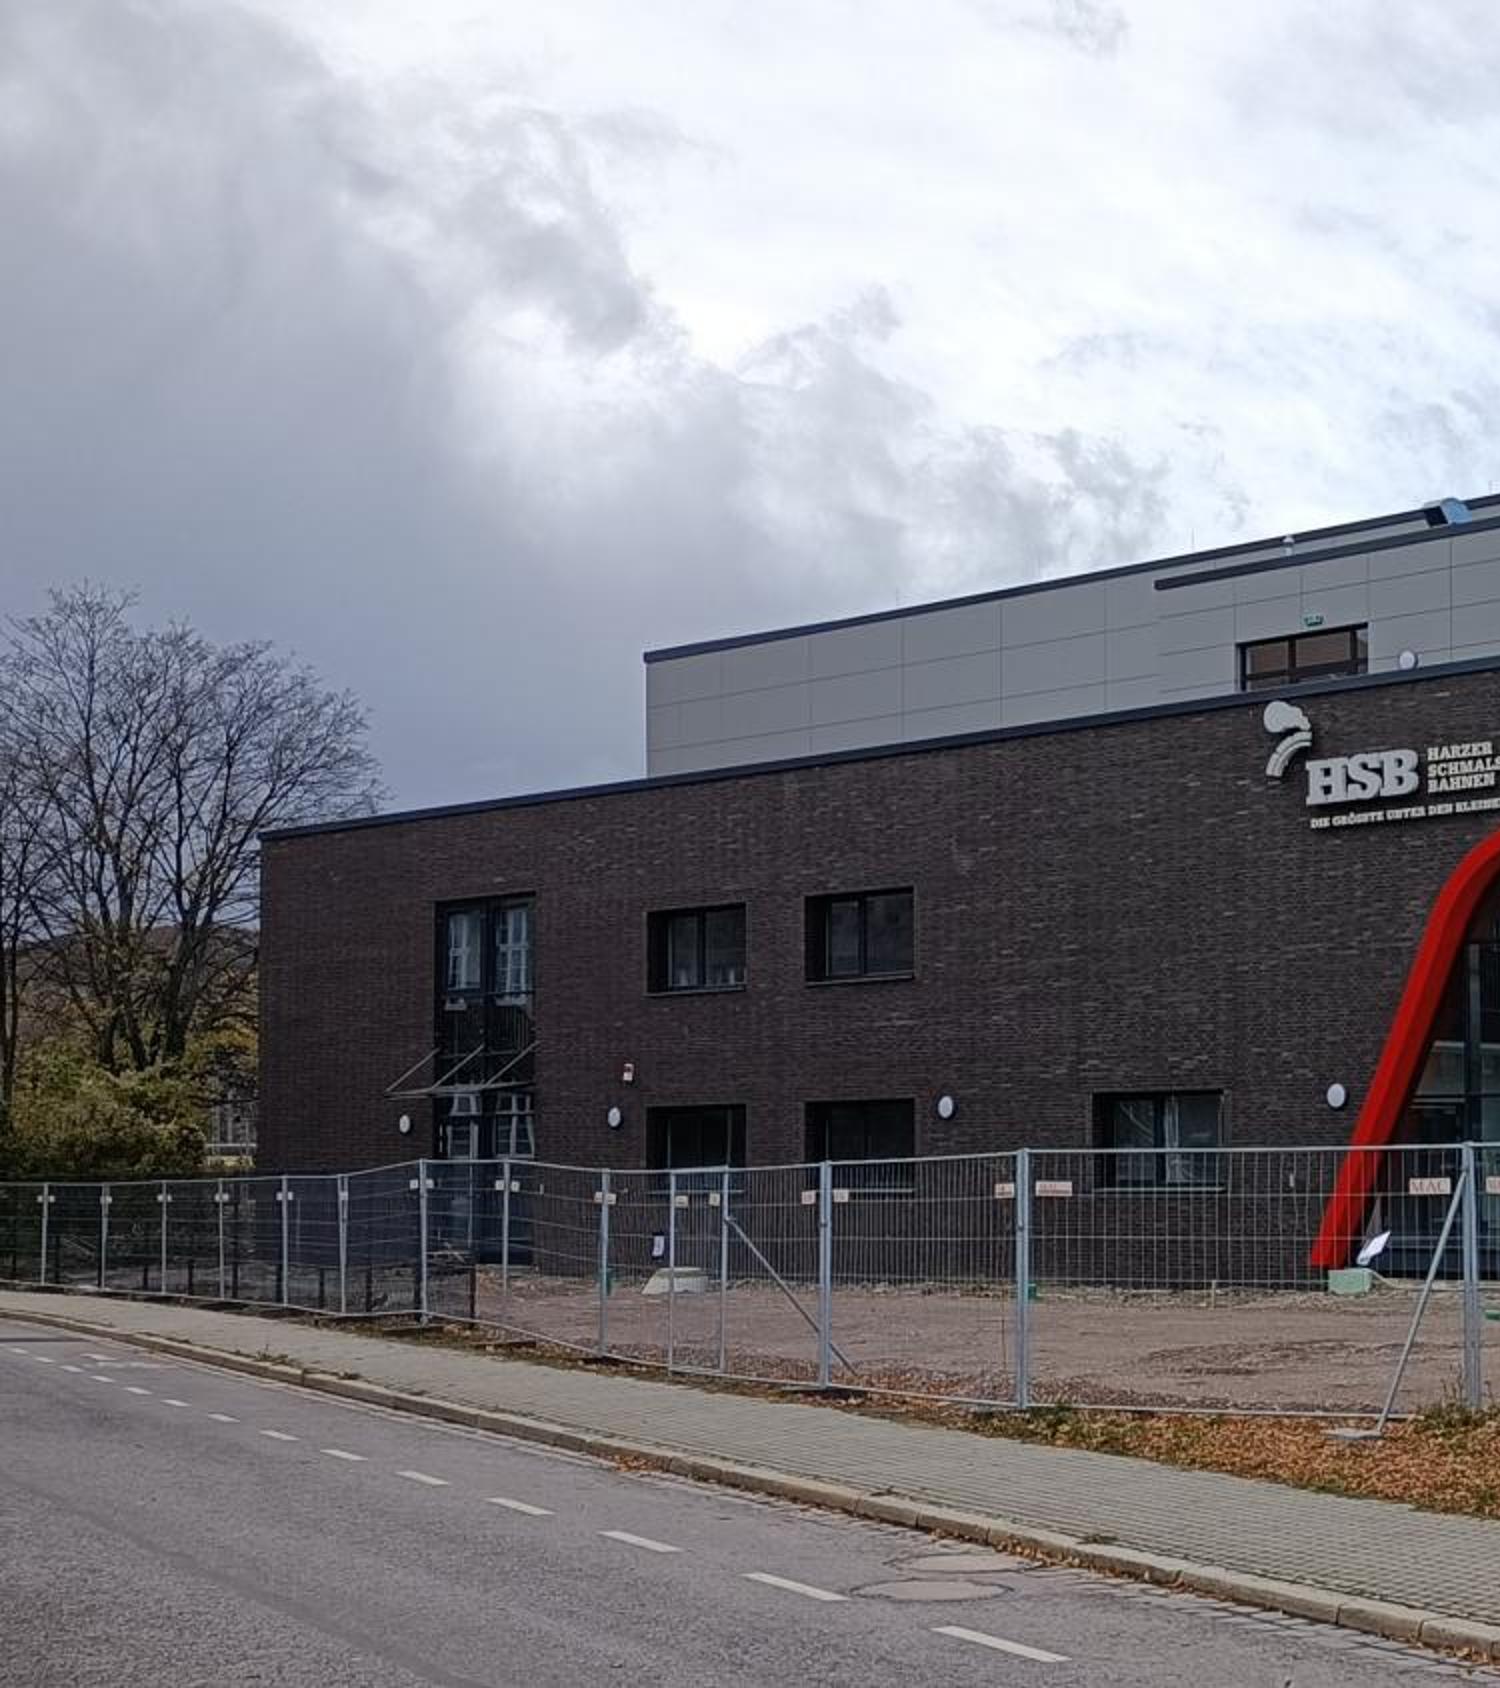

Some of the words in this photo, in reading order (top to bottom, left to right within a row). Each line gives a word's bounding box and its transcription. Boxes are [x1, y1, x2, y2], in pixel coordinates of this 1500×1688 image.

[1427, 741, 1493, 762] HARZER
[1305, 749, 1419, 806] HSB
[1427, 772, 1496, 794] BAHNEN
[1310, 817, 1331, 829] DIE
